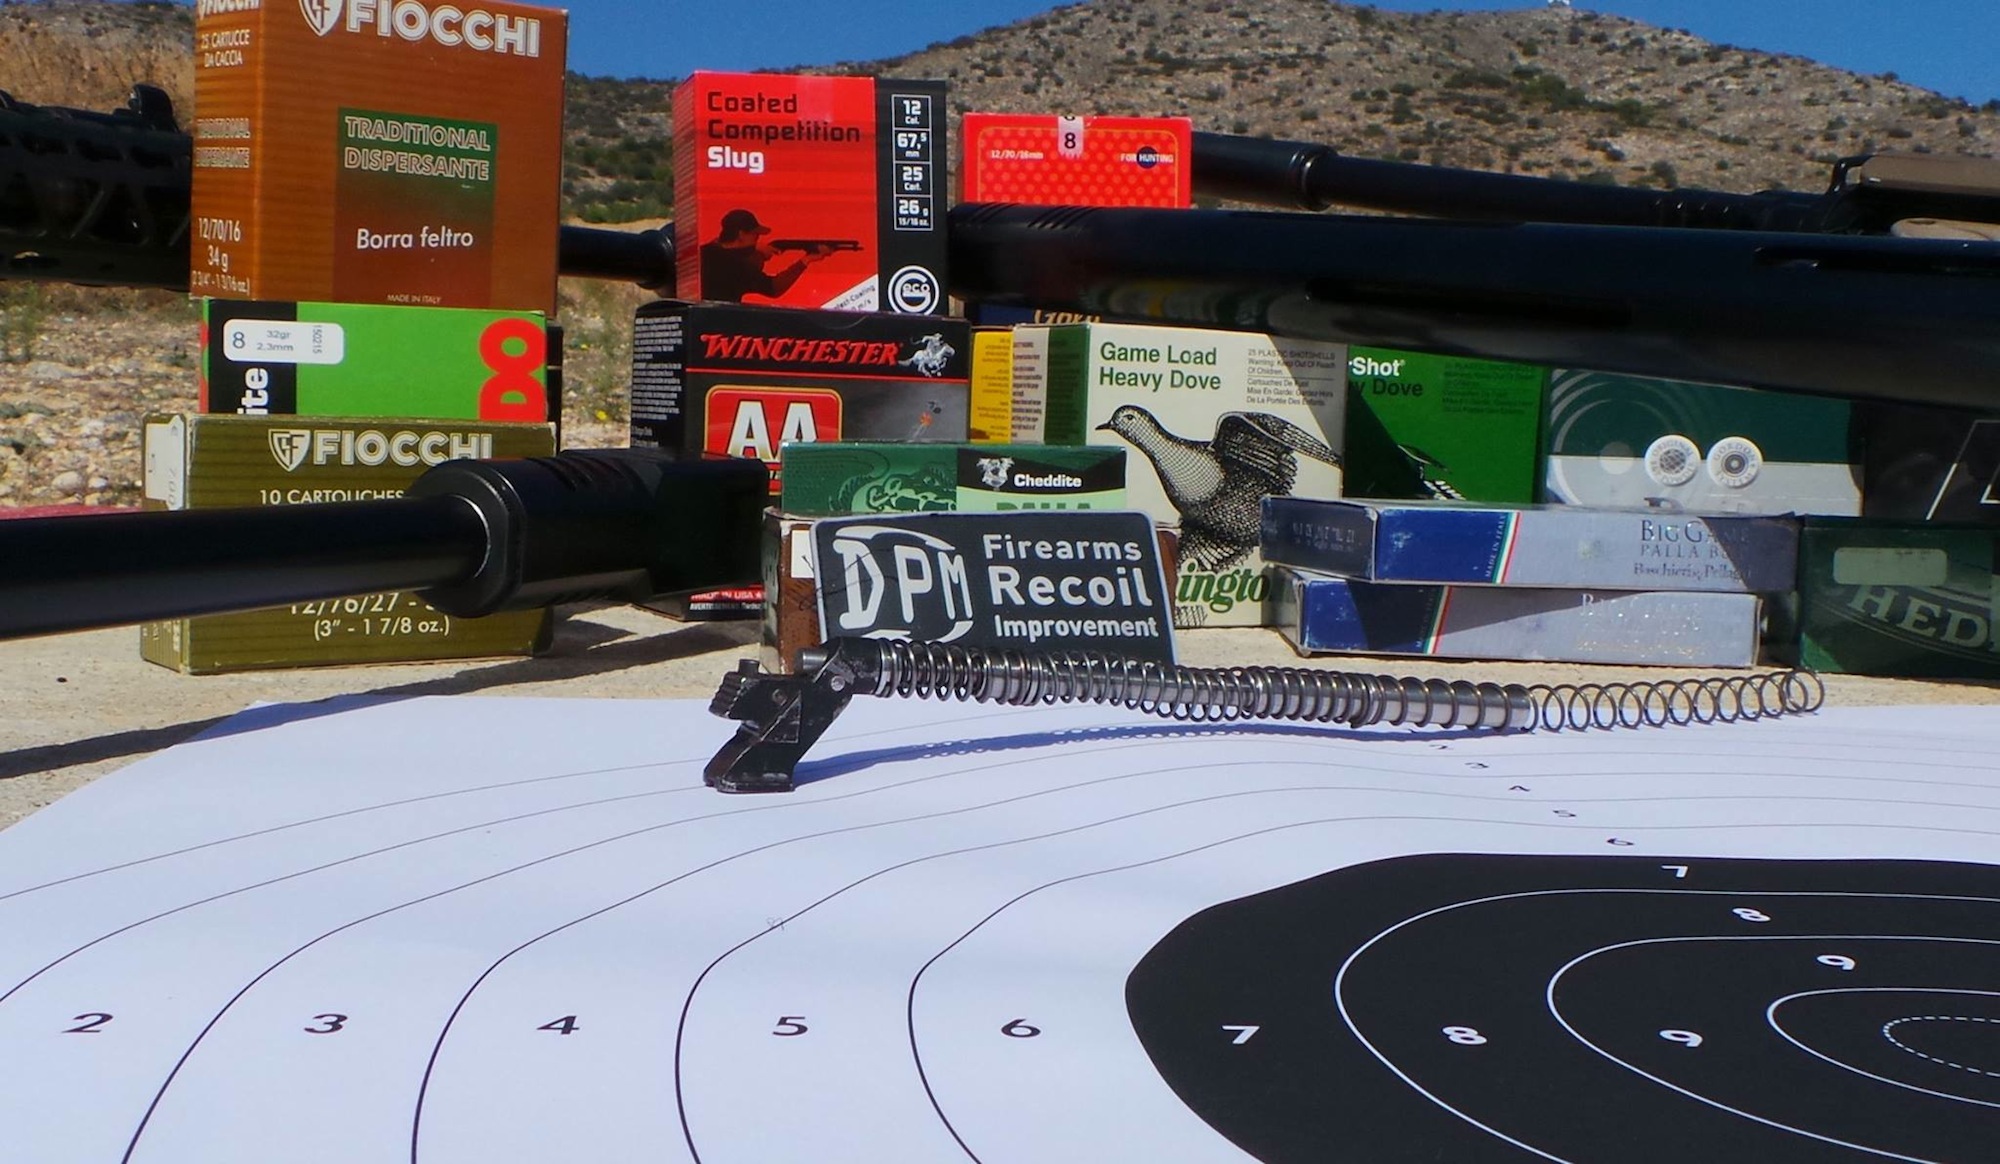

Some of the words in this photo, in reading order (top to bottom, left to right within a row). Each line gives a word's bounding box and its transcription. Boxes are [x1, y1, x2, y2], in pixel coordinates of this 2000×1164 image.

[346, 0, 541, 58] FIOCCHI
[707, 91, 798, 114] Coated
[903, 100, 922, 116] 12
[344, 116, 491, 152] TRADITIONAL
[708, 119, 860, 145] Competition
[1064, 132, 1076, 149] 8
[344, 147, 490, 181] DISPERSANTE
[708, 146, 764, 174] Slug
[905, 150, 920, 158] mm
[1120, 153, 1137, 162] FOR
[1138, 154, 1174, 163] HUNTING
[903, 166, 923, 182] 25
[898, 200, 920, 215] 26
[198, 217, 241, 242] 12/70/16
[356, 228, 413, 250] Borra
[420, 225, 474, 248] feltro
[208, 244, 220, 266] 34
[221, 253, 228, 272] g
[232, 331, 246, 349] 8
[700, 334, 900, 366] WINCHESTER
[1101, 342, 1160, 364] Game
[1167, 344, 1218, 366] Load
[1099, 366, 1162, 392] Heavy
[1170, 369, 1221, 390] Dove
[1373, 378, 1423, 397] Dove
[727, 400, 818, 463] AA
[313, 430, 493, 467] FIOCCHI
[1013, 474, 1082, 489] Cheddite
[260, 490, 282, 505] 10
[983, 534, 1143, 562] Firearms
[833, 538, 974, 631] DPM
[988, 565, 1154, 607] Recoil
[363, 619, 370, 635] 1
[380, 616, 412, 636] 7/8
[418, 614, 450, 636] oz.)
[994, 614, 1160, 643] Improvement
[1662, 866, 1688, 878] 7
[1732, 907, 1770, 922] 8
[1816, 954, 1856, 971] 9
[60, 1012, 115, 1034] 2
[303, 1012, 350, 1034] 3
[536, 1014, 580, 1036] 4
[771, 1016, 810, 1037] 5
[999, 1018, 1042, 1038] 6
[1221, 1024, 1260, 1044] 7
[1442, 1026, 1488, 1046] 8
[1660, 1029, 1703, 1048] 9
